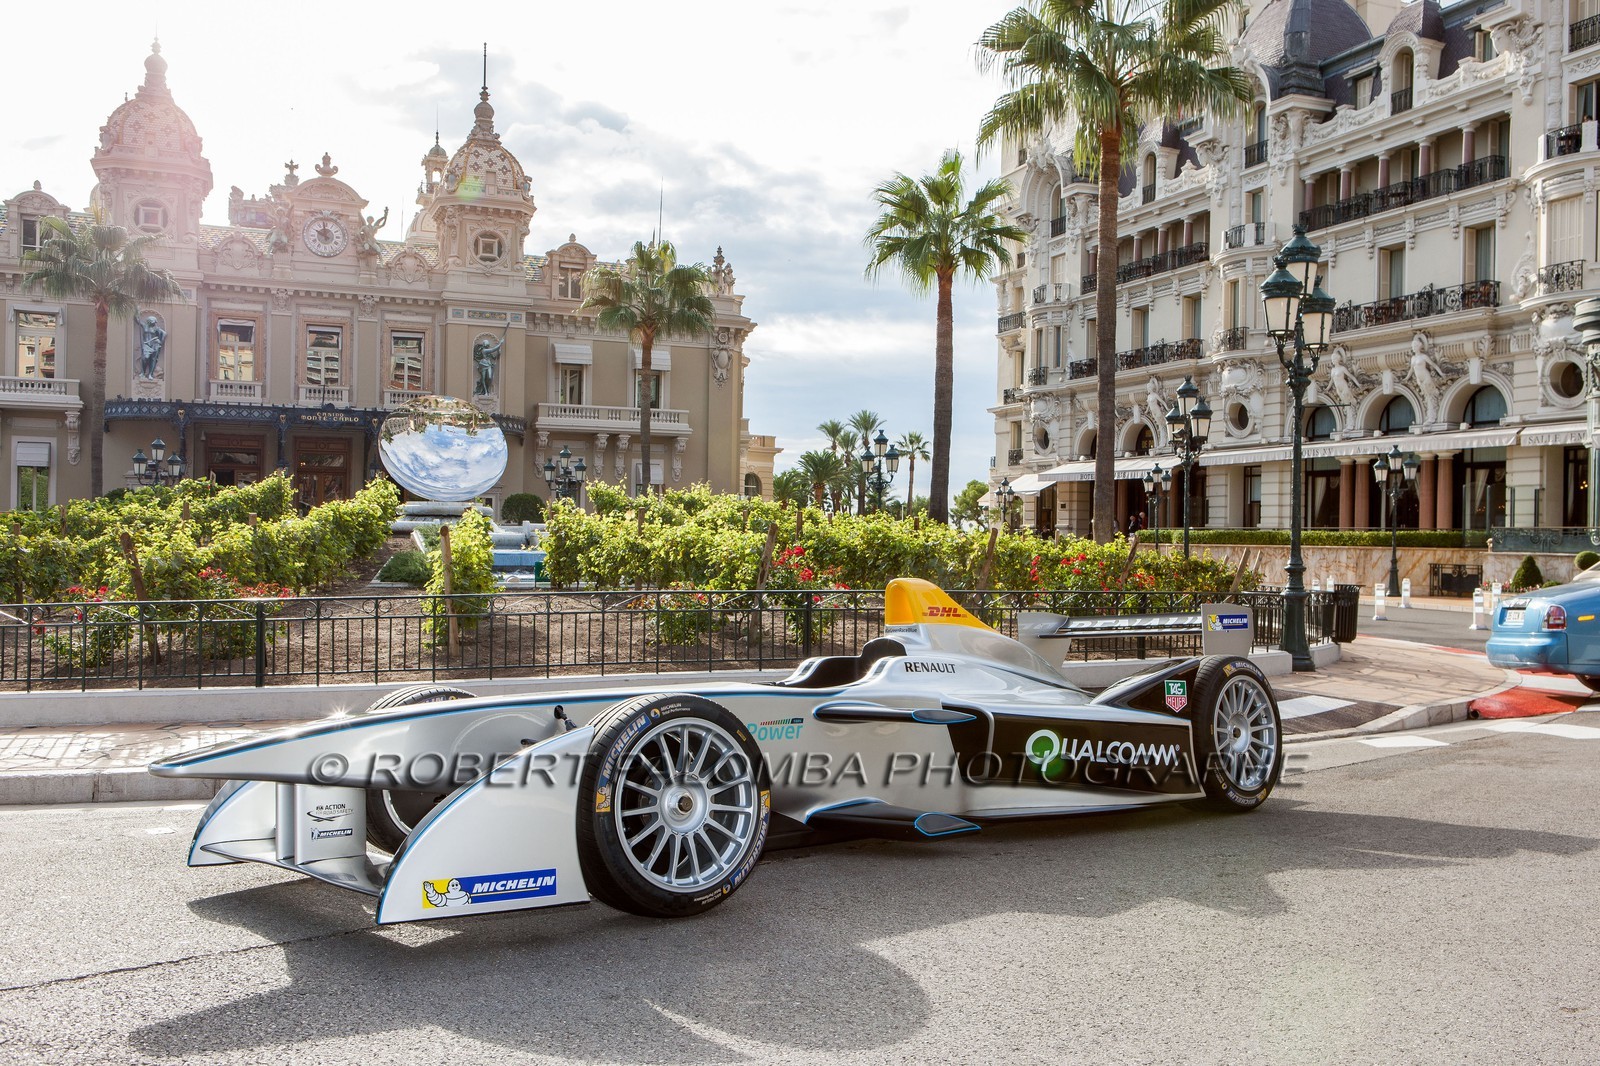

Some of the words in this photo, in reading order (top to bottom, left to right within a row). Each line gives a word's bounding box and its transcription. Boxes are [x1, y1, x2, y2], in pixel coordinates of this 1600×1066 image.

[1528, 434, 1560, 444] SALLE
[927, 606, 962, 618] DHL
[1222, 617, 1248, 625] MICHELIN
[904, 661, 956, 674] RENAULT
[1168, 682, 1184, 695] TAG
[1167, 697, 1186, 710] HEUER
[602, 714, 647, 780] MICHELIN
[325, 803, 346, 811] ACTION
[320, 829, 352, 837] MICHELIN
[472, 875, 556, 894] MICHELIN
